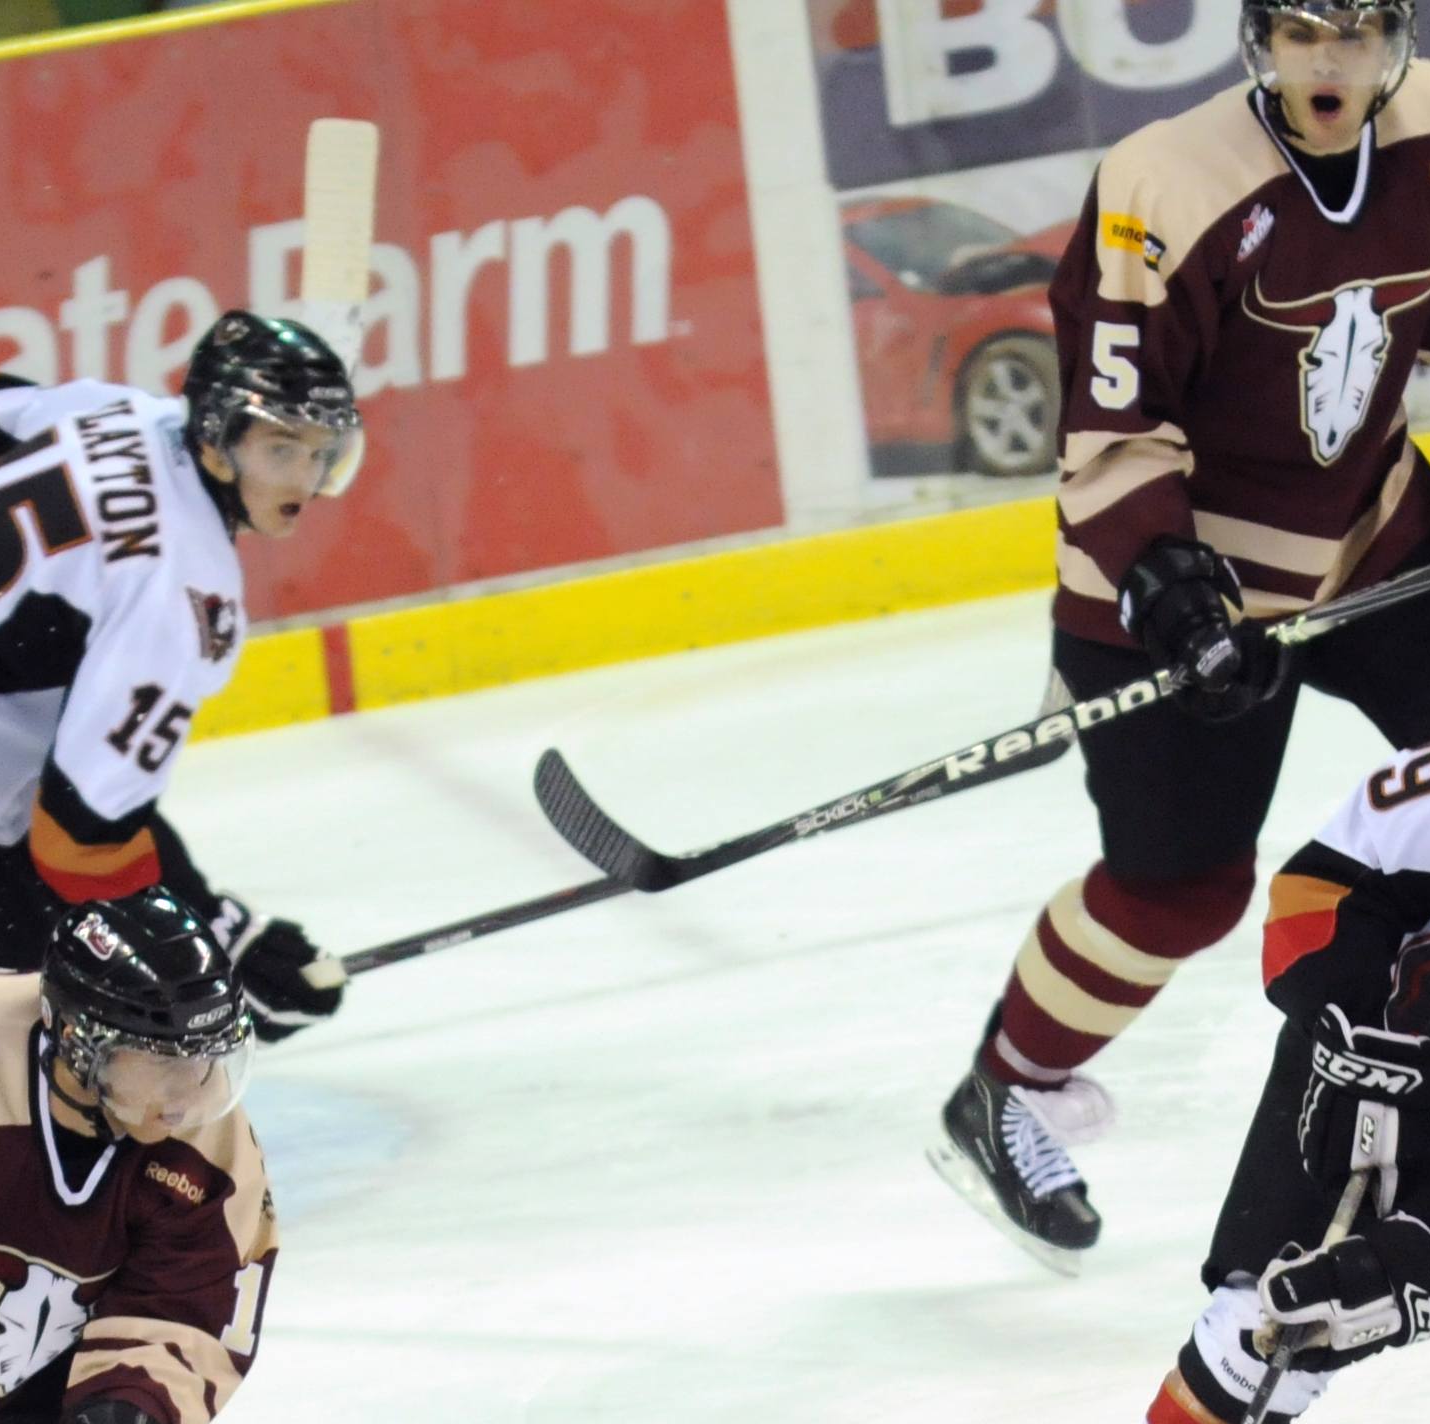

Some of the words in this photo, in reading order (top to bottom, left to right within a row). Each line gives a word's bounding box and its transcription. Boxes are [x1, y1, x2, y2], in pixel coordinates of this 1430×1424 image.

[1090, 320, 1140, 411] 5
[71, 398, 163, 564] LAYTON
[106, 682, 194, 775] 15
[944, 668, 1191, 782] Reebok
[1313, 1041, 1409, 1095] CCM
[144, 1160, 207, 1205] Reebok
[1220, 1356, 1259, 1393] Reebo
